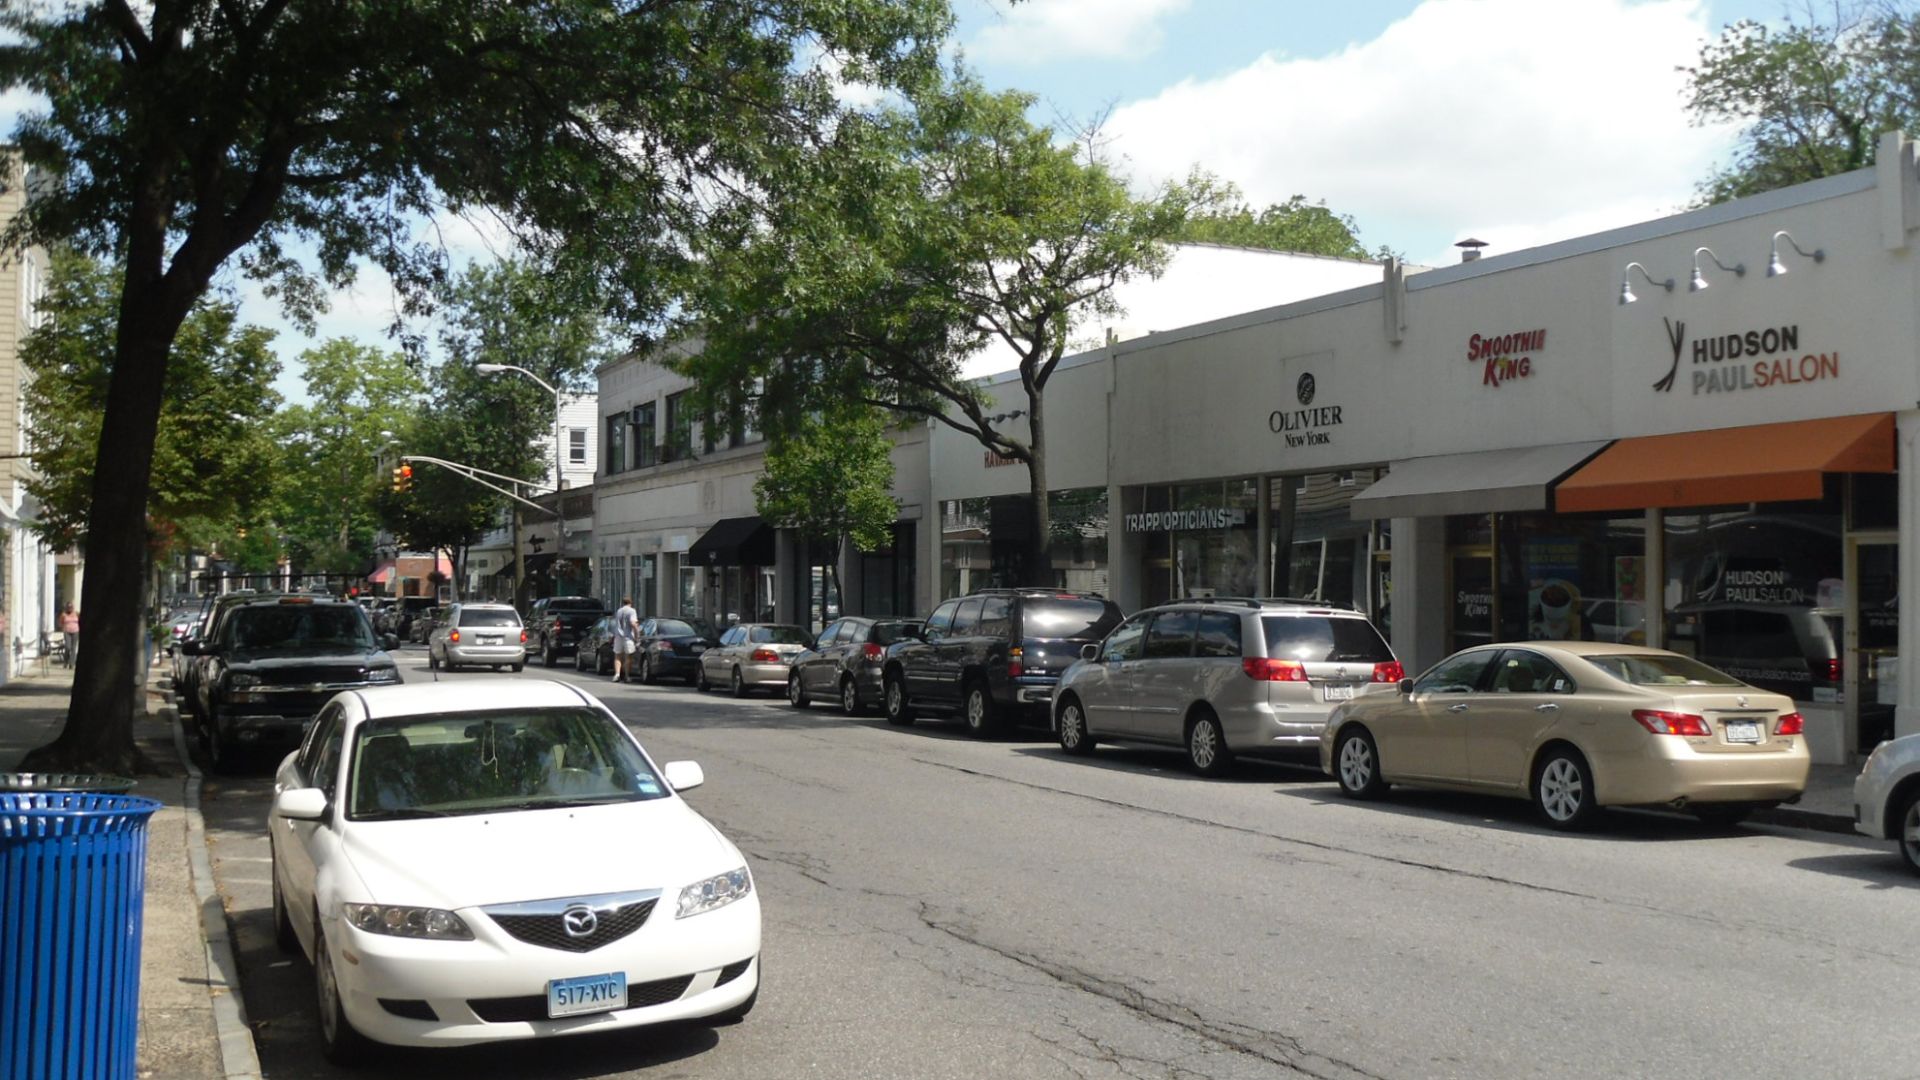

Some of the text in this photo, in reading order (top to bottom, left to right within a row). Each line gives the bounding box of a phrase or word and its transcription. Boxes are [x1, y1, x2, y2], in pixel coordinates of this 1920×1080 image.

[1468, 328, 1547, 361] SMOOTHIE
[1692, 325, 1799, 364] HUDSON
[1483, 357, 1530, 387] KING
[1268, 405, 1343, 434] OLIVIER
[1285, 431, 1331, 448] NEW YORK
[1125, 508, 1226, 532] TRAPP OPTICIANS
[1725, 570, 1784, 585] HUDSON
[1464, 603, 1488, 618] KING
[558, 981, 618, 1006] 517-XYC
